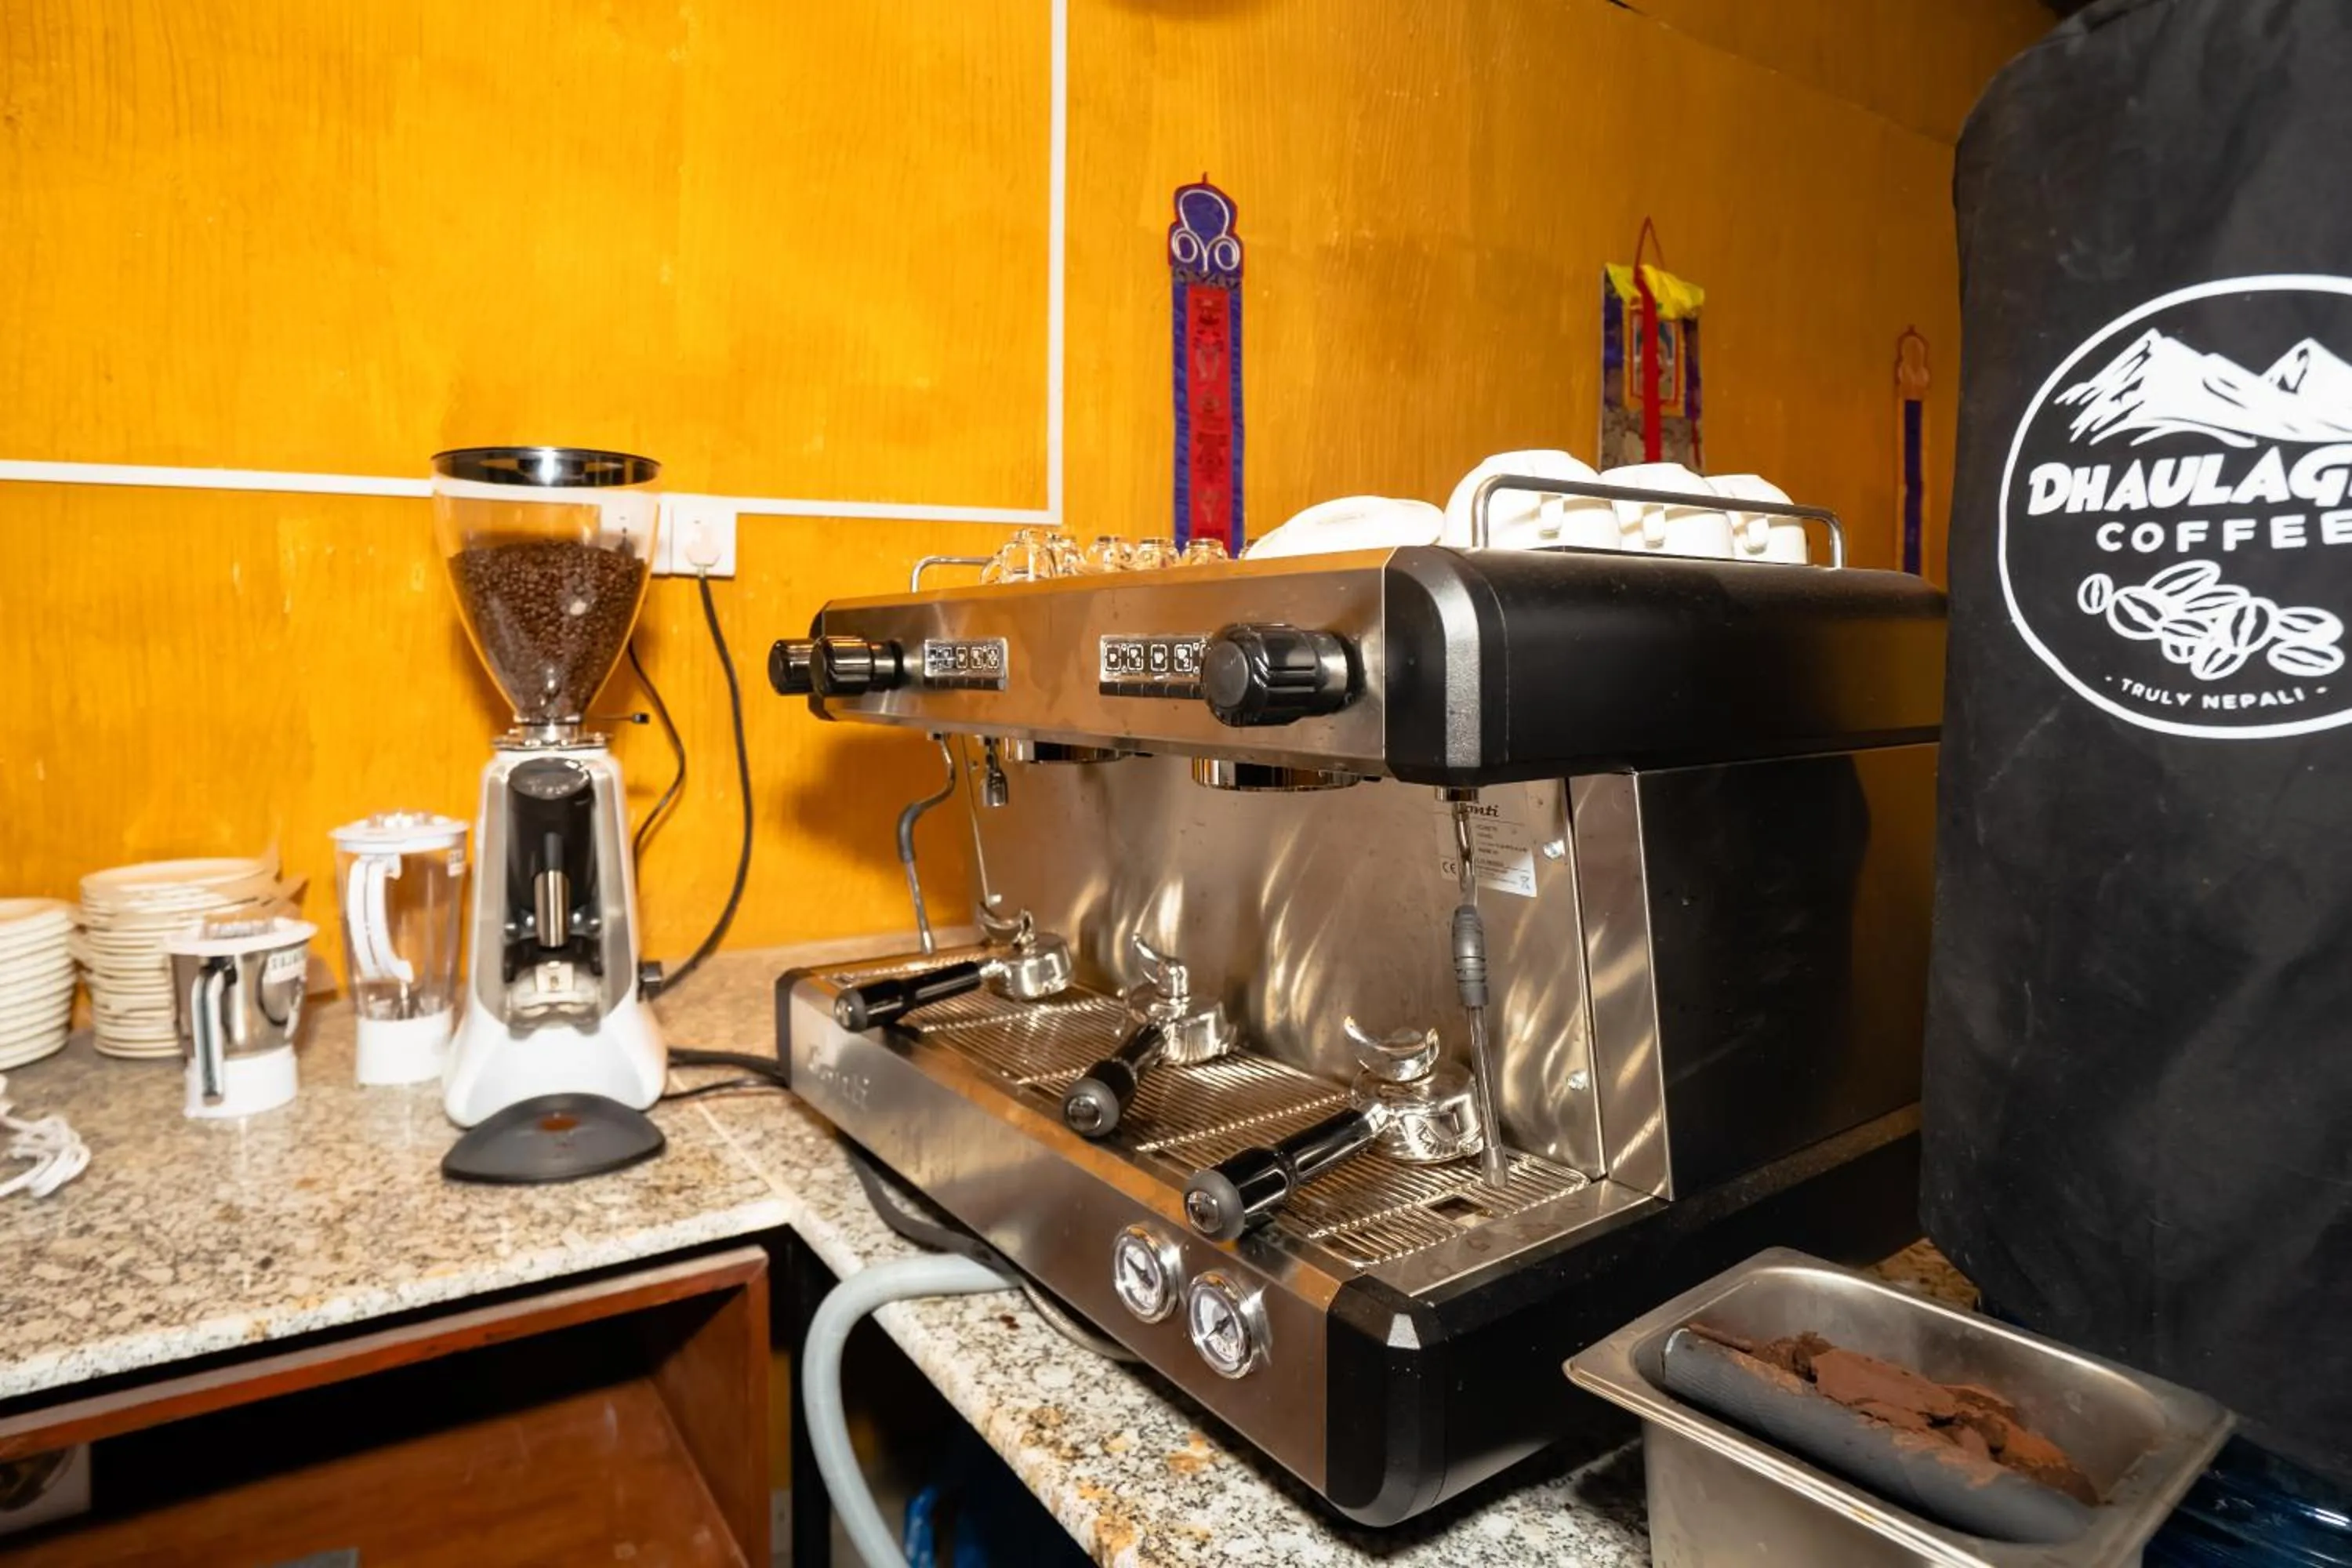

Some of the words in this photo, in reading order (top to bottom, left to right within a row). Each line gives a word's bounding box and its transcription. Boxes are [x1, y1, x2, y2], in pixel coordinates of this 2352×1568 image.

[2027, 445, 2352, 516] DHAULAG
[2096, 509, 2352, 553] COFFEE
[2121, 677, 2192, 706] TRULY
[2201, 686, 2306, 710] NEPALI
